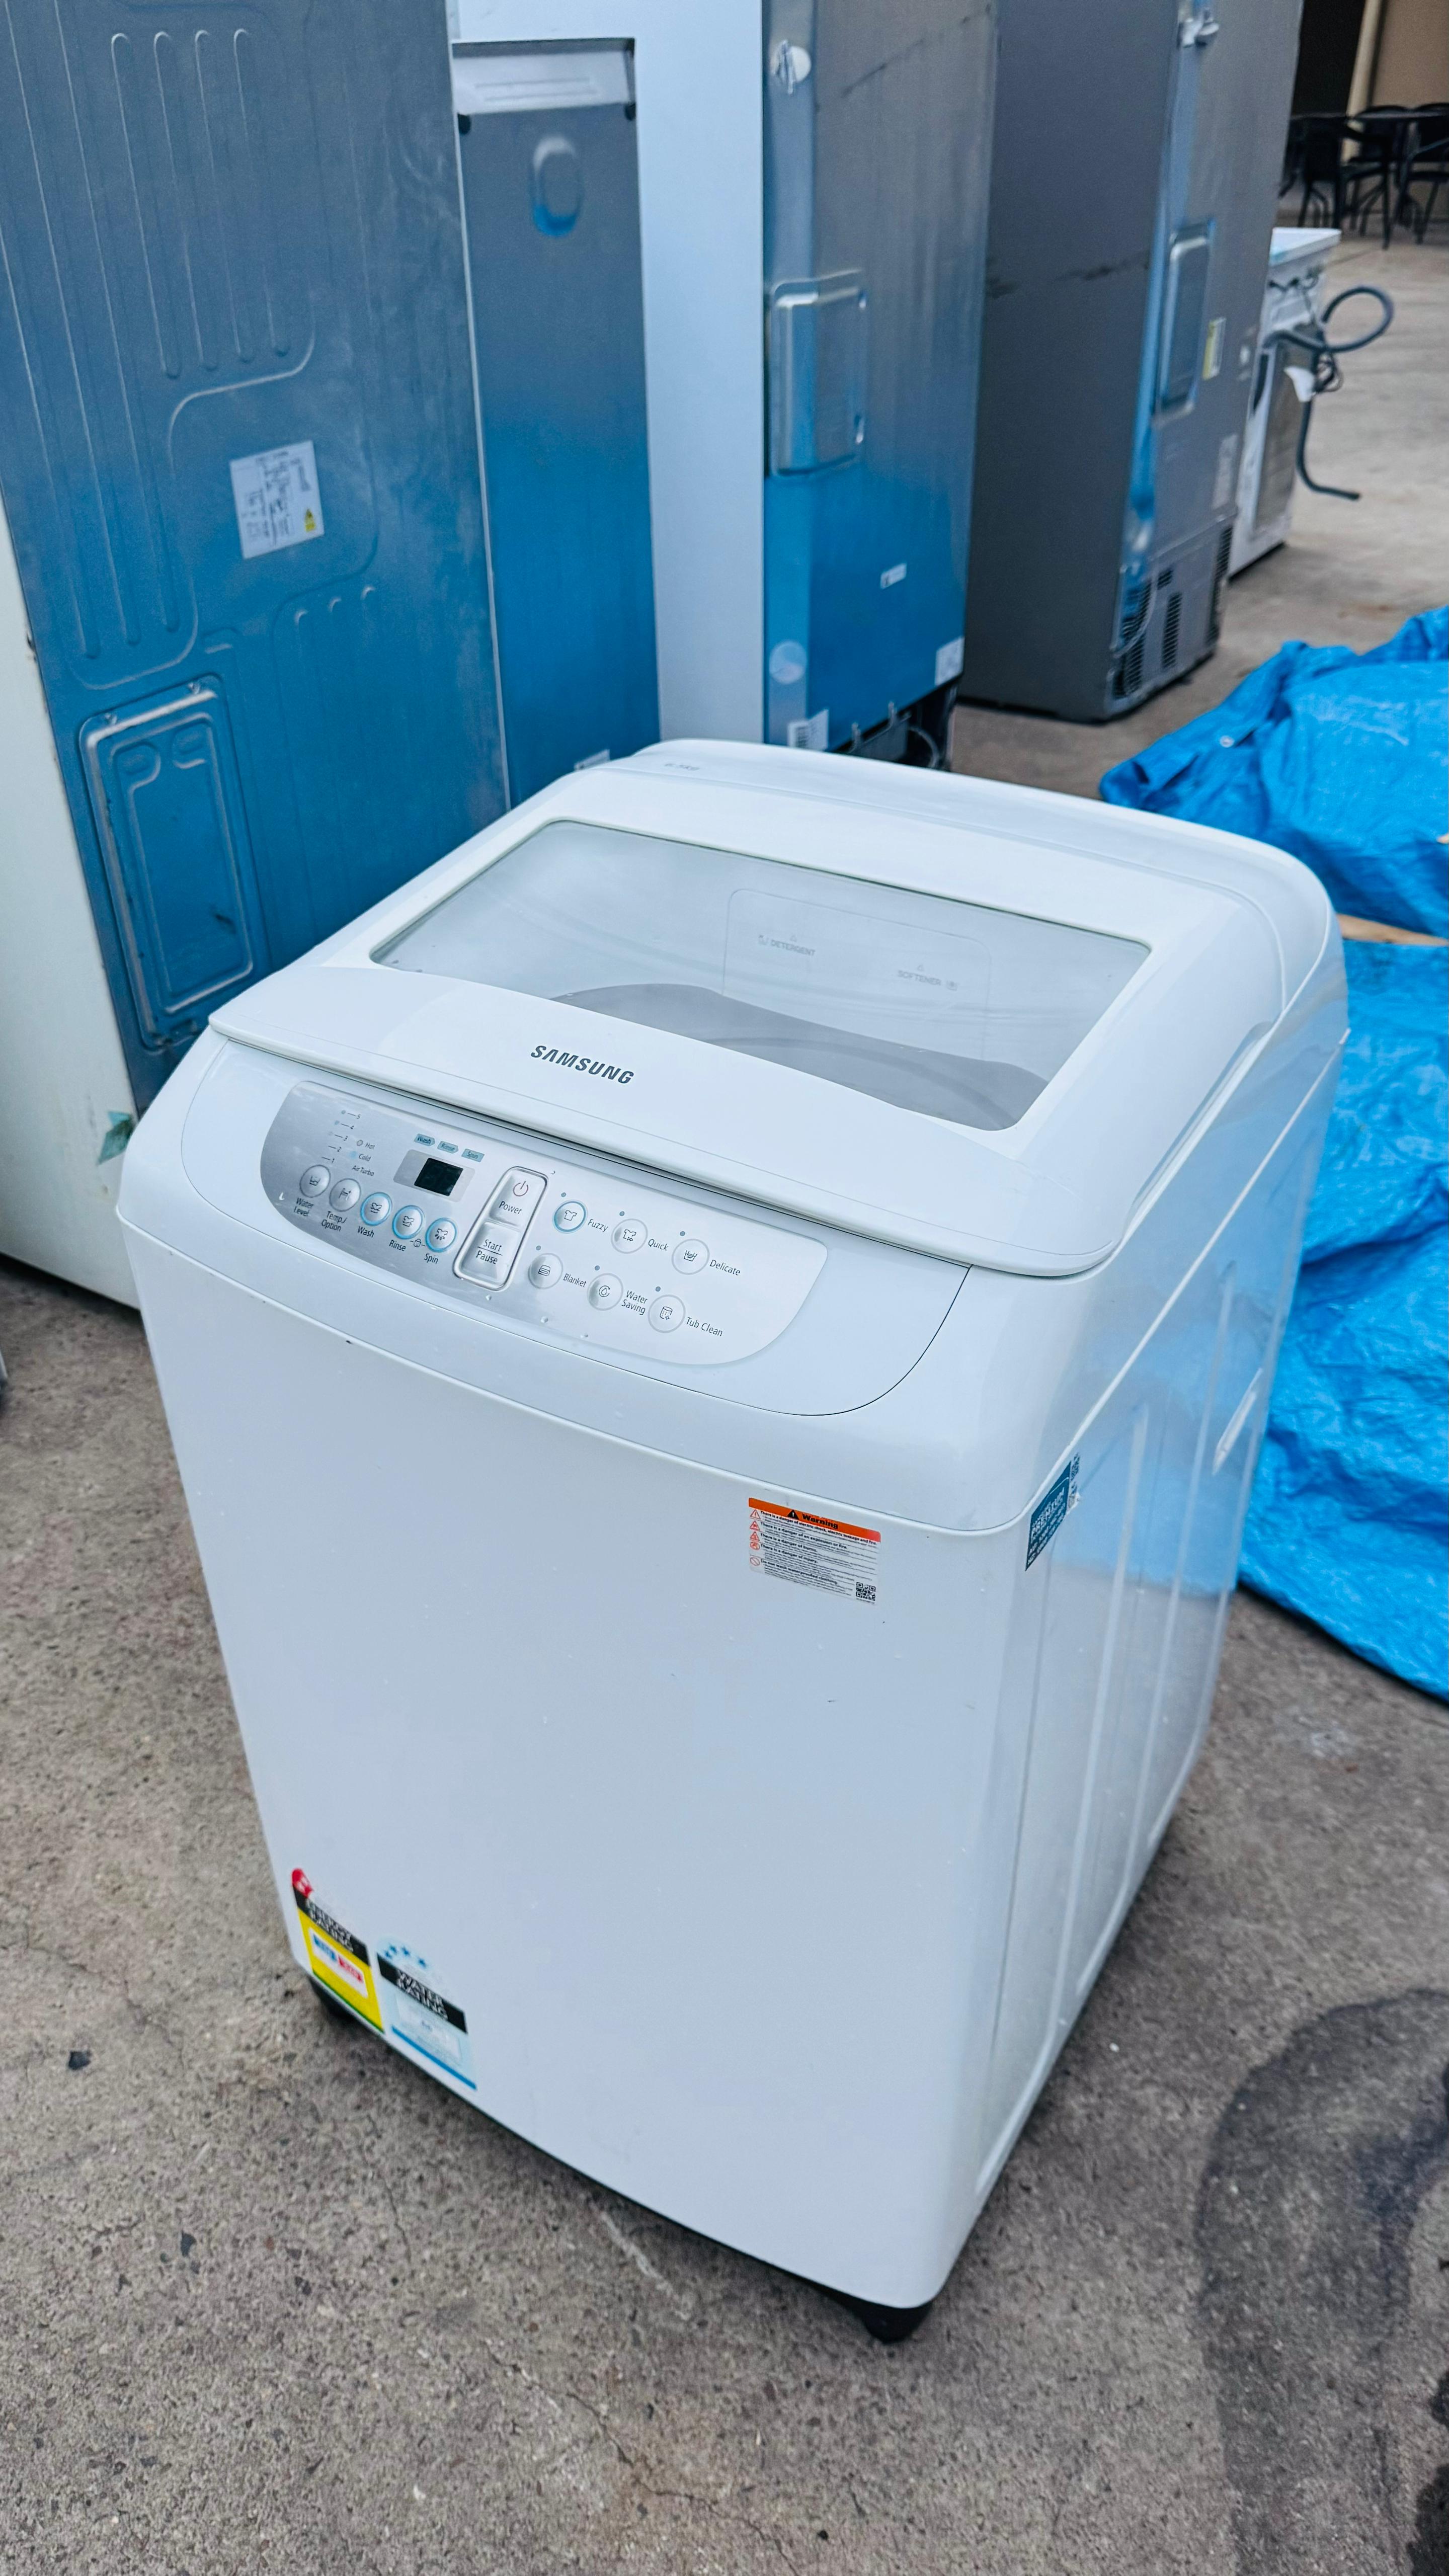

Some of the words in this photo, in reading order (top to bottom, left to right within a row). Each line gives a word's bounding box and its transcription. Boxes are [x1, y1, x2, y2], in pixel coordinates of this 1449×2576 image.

[770, 939, 815, 956] DETERGENT
[897, 970, 941, 986] SOFTENER
[531, 1045, 634, 1084] SAMSUNG
[359, 1153, 371, 1162] Cold
[467, 1150, 478, 1160] Spin
[296, 1197, 314, 1210] Water
[499, 1200, 523, 1216] Power
[321, 1219, 342, 1232] Option
[357, 1226, 374, 1238] Wash
[587, 1218, 608, 1233] Fuzzy
[389, 1240, 406, 1252] Rinse
[482, 1238, 502, 1252] Start
[648, 1239, 669, 1252] Quick
[424, 1253, 438, 1264] Spin
[476, 1250, 498, 1264] Pause
[710, 1259, 741, 1276] Delicate
[563, 1272, 587, 1287] Blanket
[626, 1290, 648, 1304] Water
[622, 1300, 646, 1315] Saving
[686, 1317, 699, 1329] Tub
[701, 1322, 723, 1337] Clean
[802, 1513, 839, 1530] Warning
